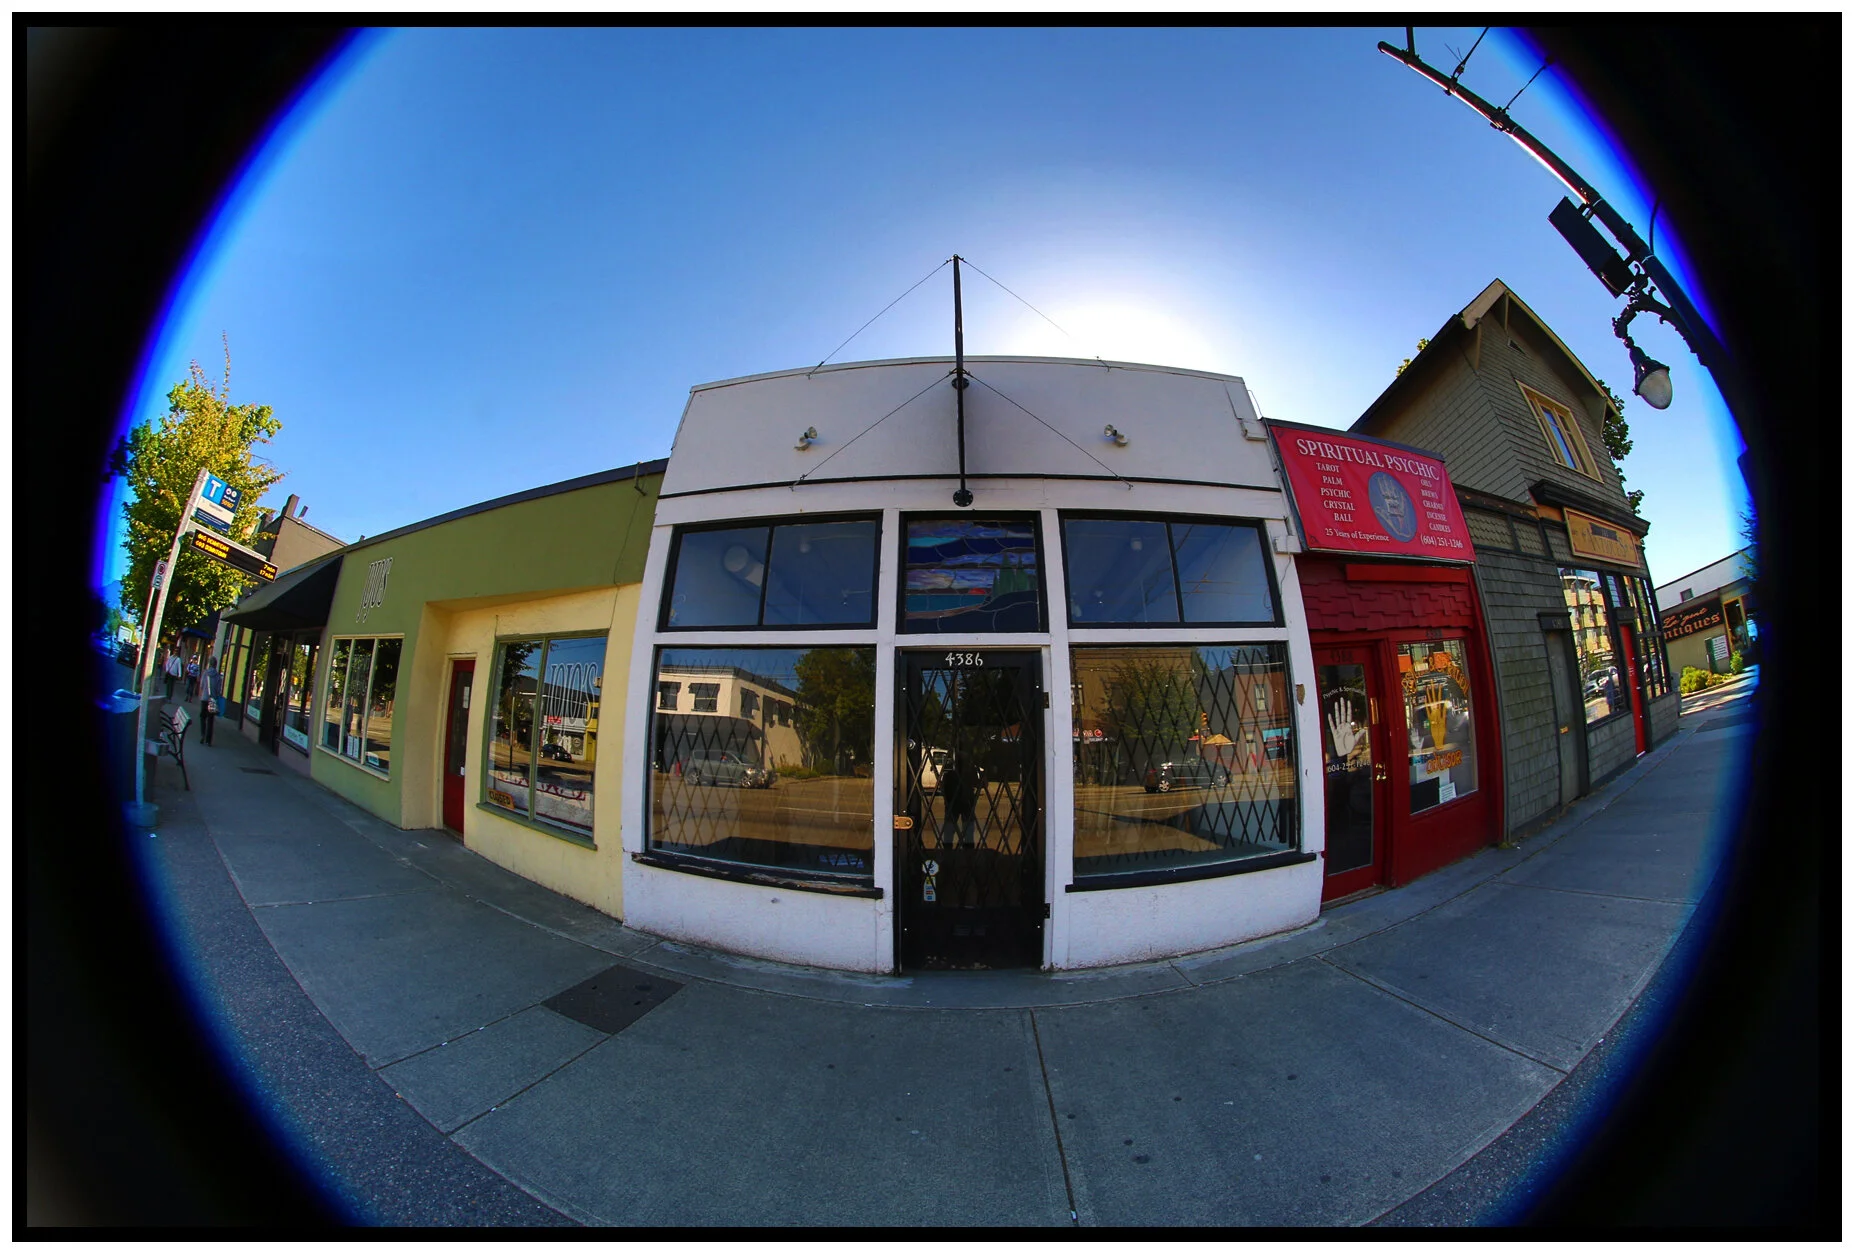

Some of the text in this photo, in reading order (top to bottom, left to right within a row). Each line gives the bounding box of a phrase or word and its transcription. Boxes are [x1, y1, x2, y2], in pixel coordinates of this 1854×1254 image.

[1296, 438, 1440, 480] SPIRITUAL PSYCHIC
[1316, 462, 1340, 473] TAROT
[1322, 475, 1343, 485] PALM
[209, 479, 222, 498] T
[1320, 487, 1351, 499] PSYCHIC
[1323, 500, 1355, 511] CRYSTAL
[1334, 512, 1353, 522] BALL
[1429, 522, 1451, 533] CANDLES
[1325, 528, 1390, 542] 25 Years of Experience
[1420, 533, 1437, 546] (604)
[1664, 612, 1721, 639] ntiques
[945, 652, 984, 667] 4386
[1322, 687, 1339, 699] Psychic
